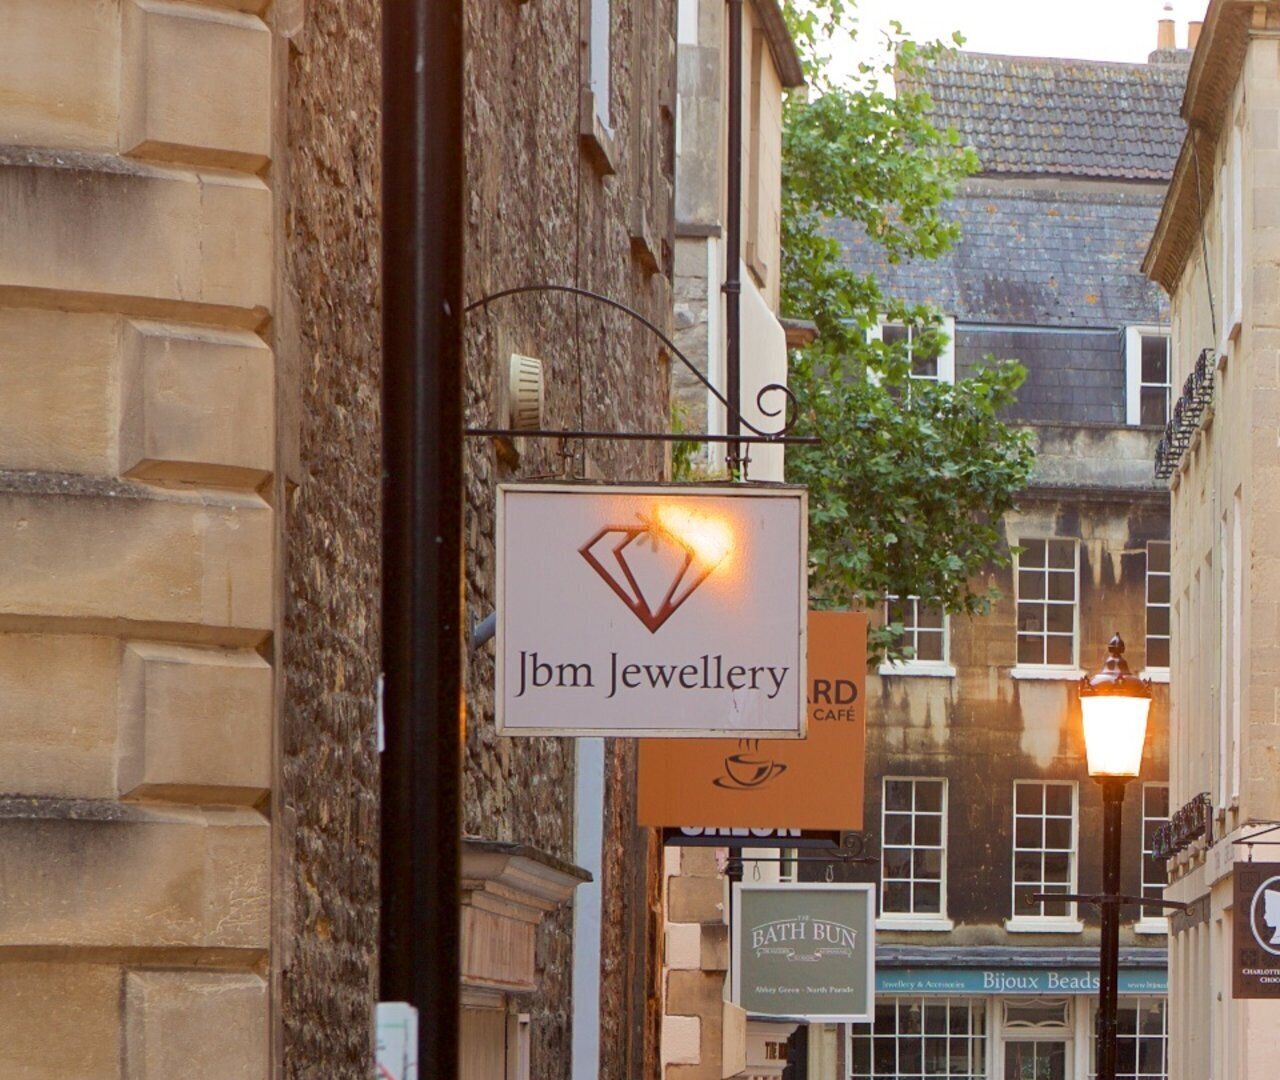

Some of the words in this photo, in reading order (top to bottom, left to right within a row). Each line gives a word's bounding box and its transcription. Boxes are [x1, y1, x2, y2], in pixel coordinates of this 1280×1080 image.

[514, 650, 595, 698] Jbm
[605, 651, 790, 699] Jewellery
[807, 678, 858, 706] RD
[813, 705, 856, 722] CAFÉ
[751, 921, 806, 949] BATH
[812, 922, 857, 949] BUN
[983, 971, 1038, 991] Bijoux
[1047, 971, 1100, 989] Beads
